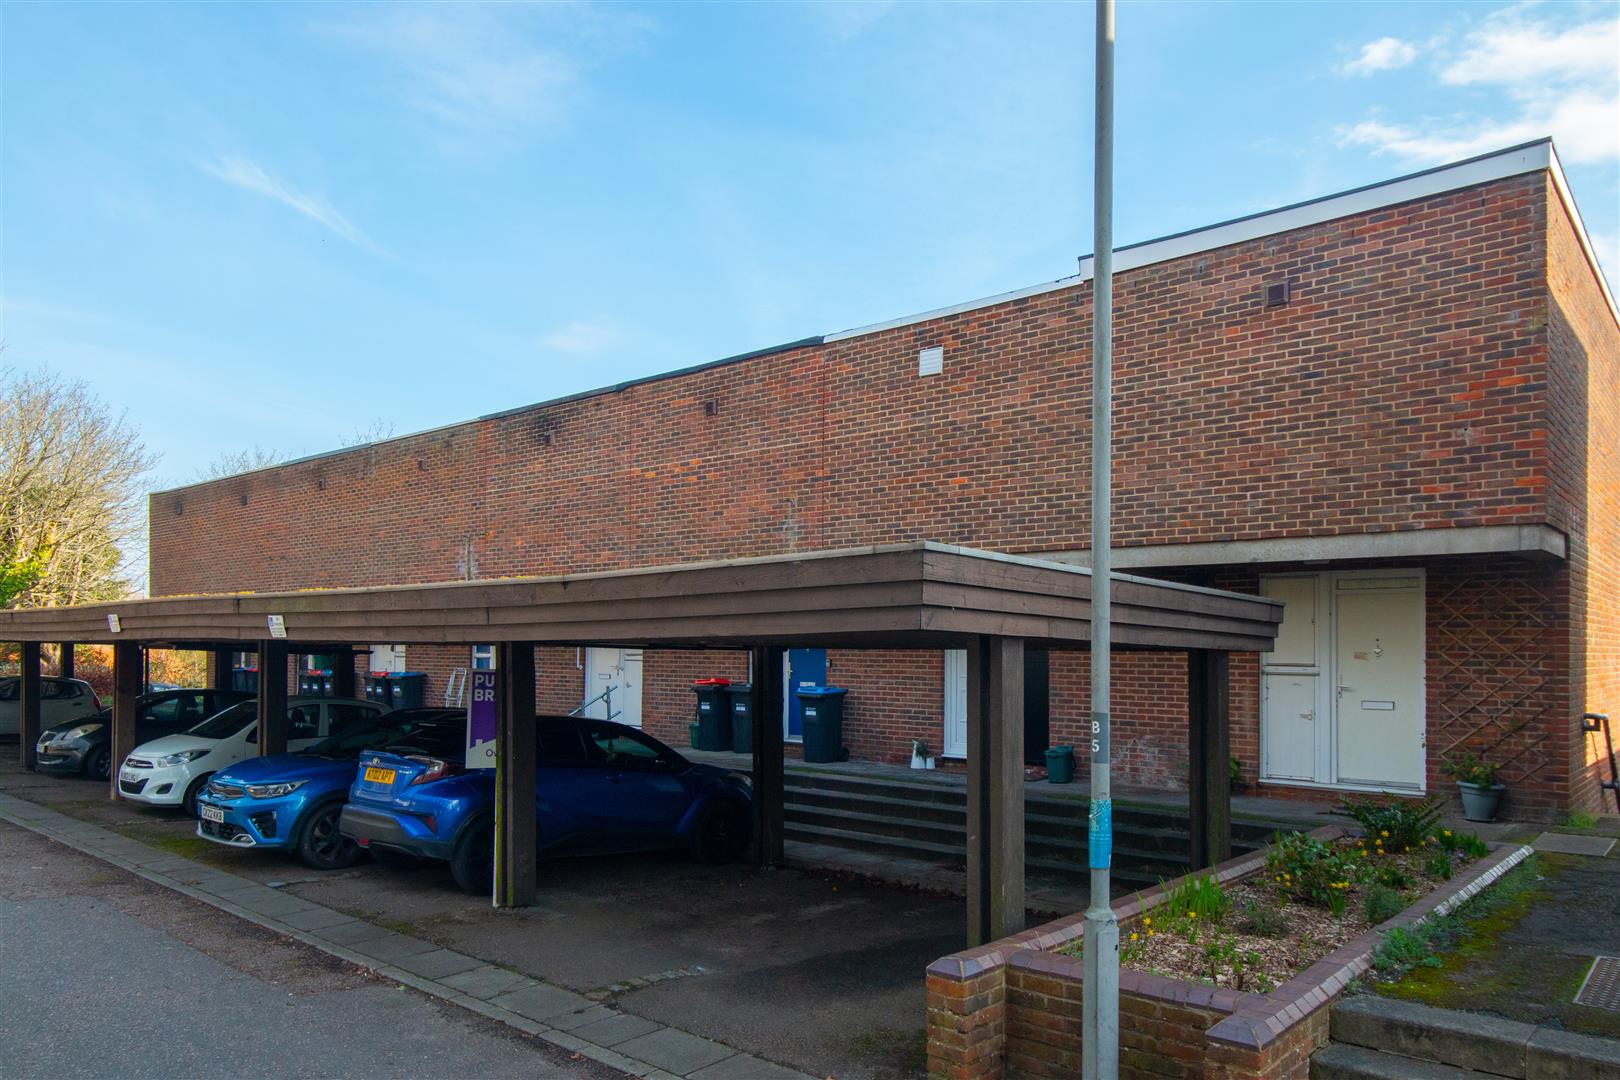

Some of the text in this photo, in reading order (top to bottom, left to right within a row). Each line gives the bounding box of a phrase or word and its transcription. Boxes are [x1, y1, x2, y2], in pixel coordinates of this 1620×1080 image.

[475, 674, 495, 687] PU
[474, 689, 496, 702] BR
[1092, 720, 1100, 734] B
[1092, 739, 1100, 753] 5
